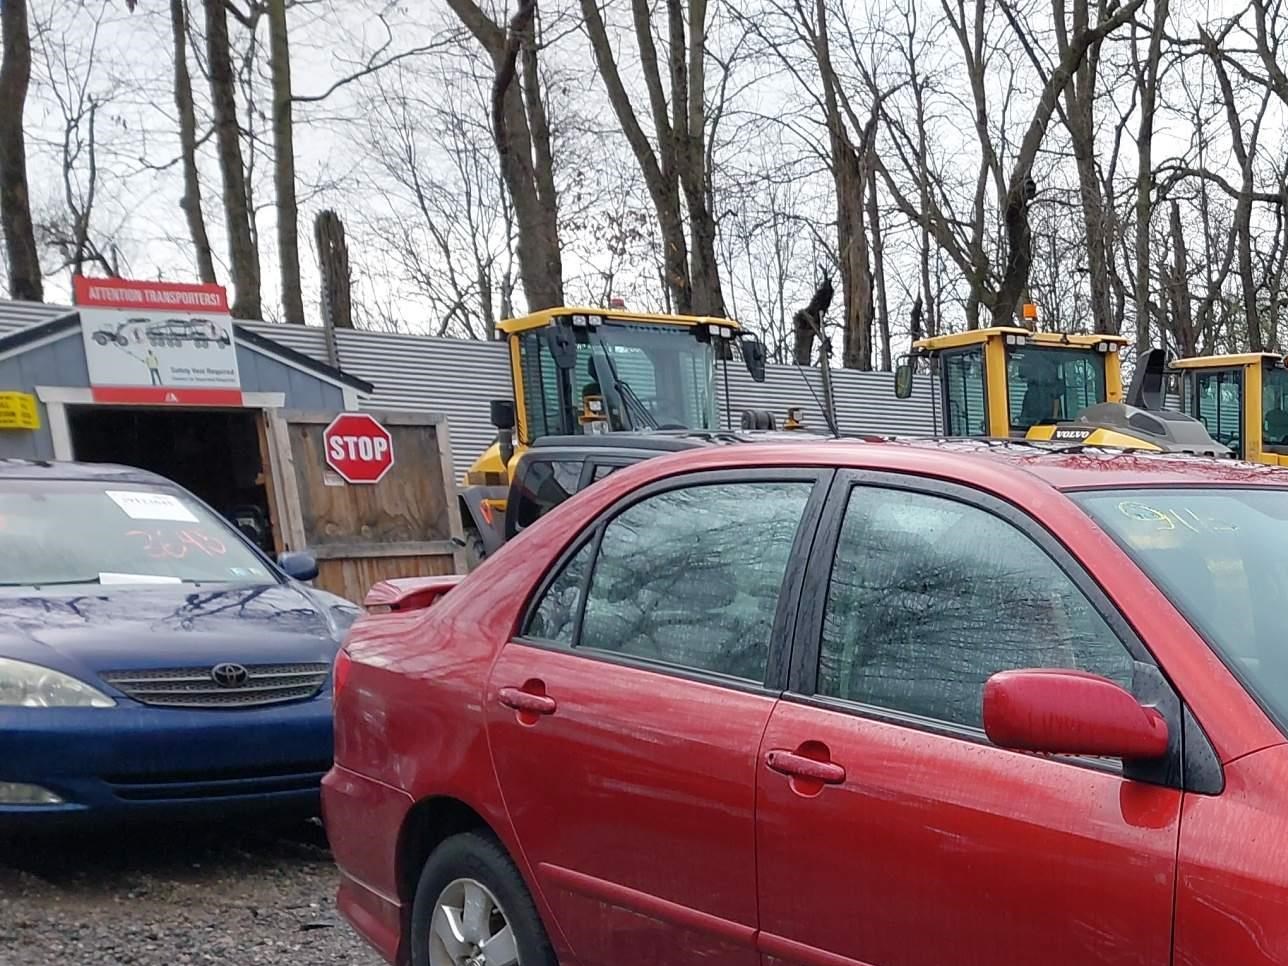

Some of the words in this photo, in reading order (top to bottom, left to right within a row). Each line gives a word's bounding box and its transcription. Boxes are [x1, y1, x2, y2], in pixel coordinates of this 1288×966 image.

[89, 286, 143, 303] ATTENTION
[143, 289, 221, 306] TRANSPORTERS!
[1056, 430, 1090, 439] VOLVO
[329, 435, 388, 461] STOP
